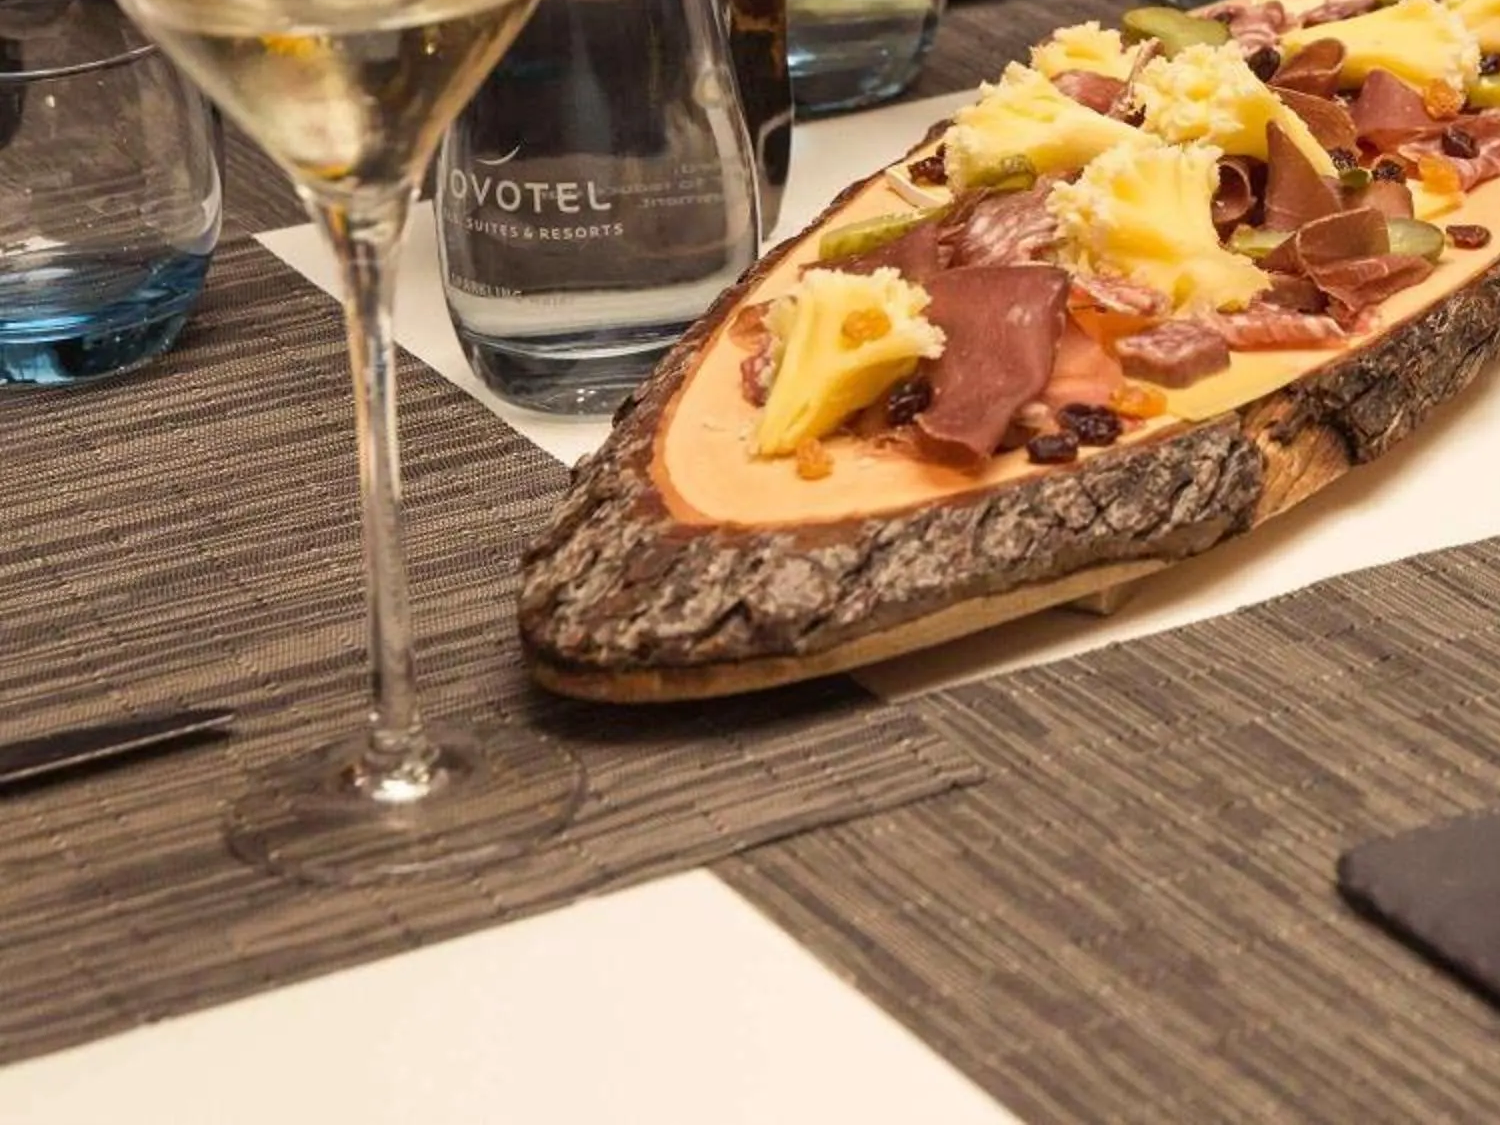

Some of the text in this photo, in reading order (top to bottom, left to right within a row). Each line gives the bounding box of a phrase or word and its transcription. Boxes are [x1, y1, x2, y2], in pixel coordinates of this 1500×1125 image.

[451, 169, 612, 213] OVOTEL
[467, 217, 624, 241] SUITES & RESORTS
